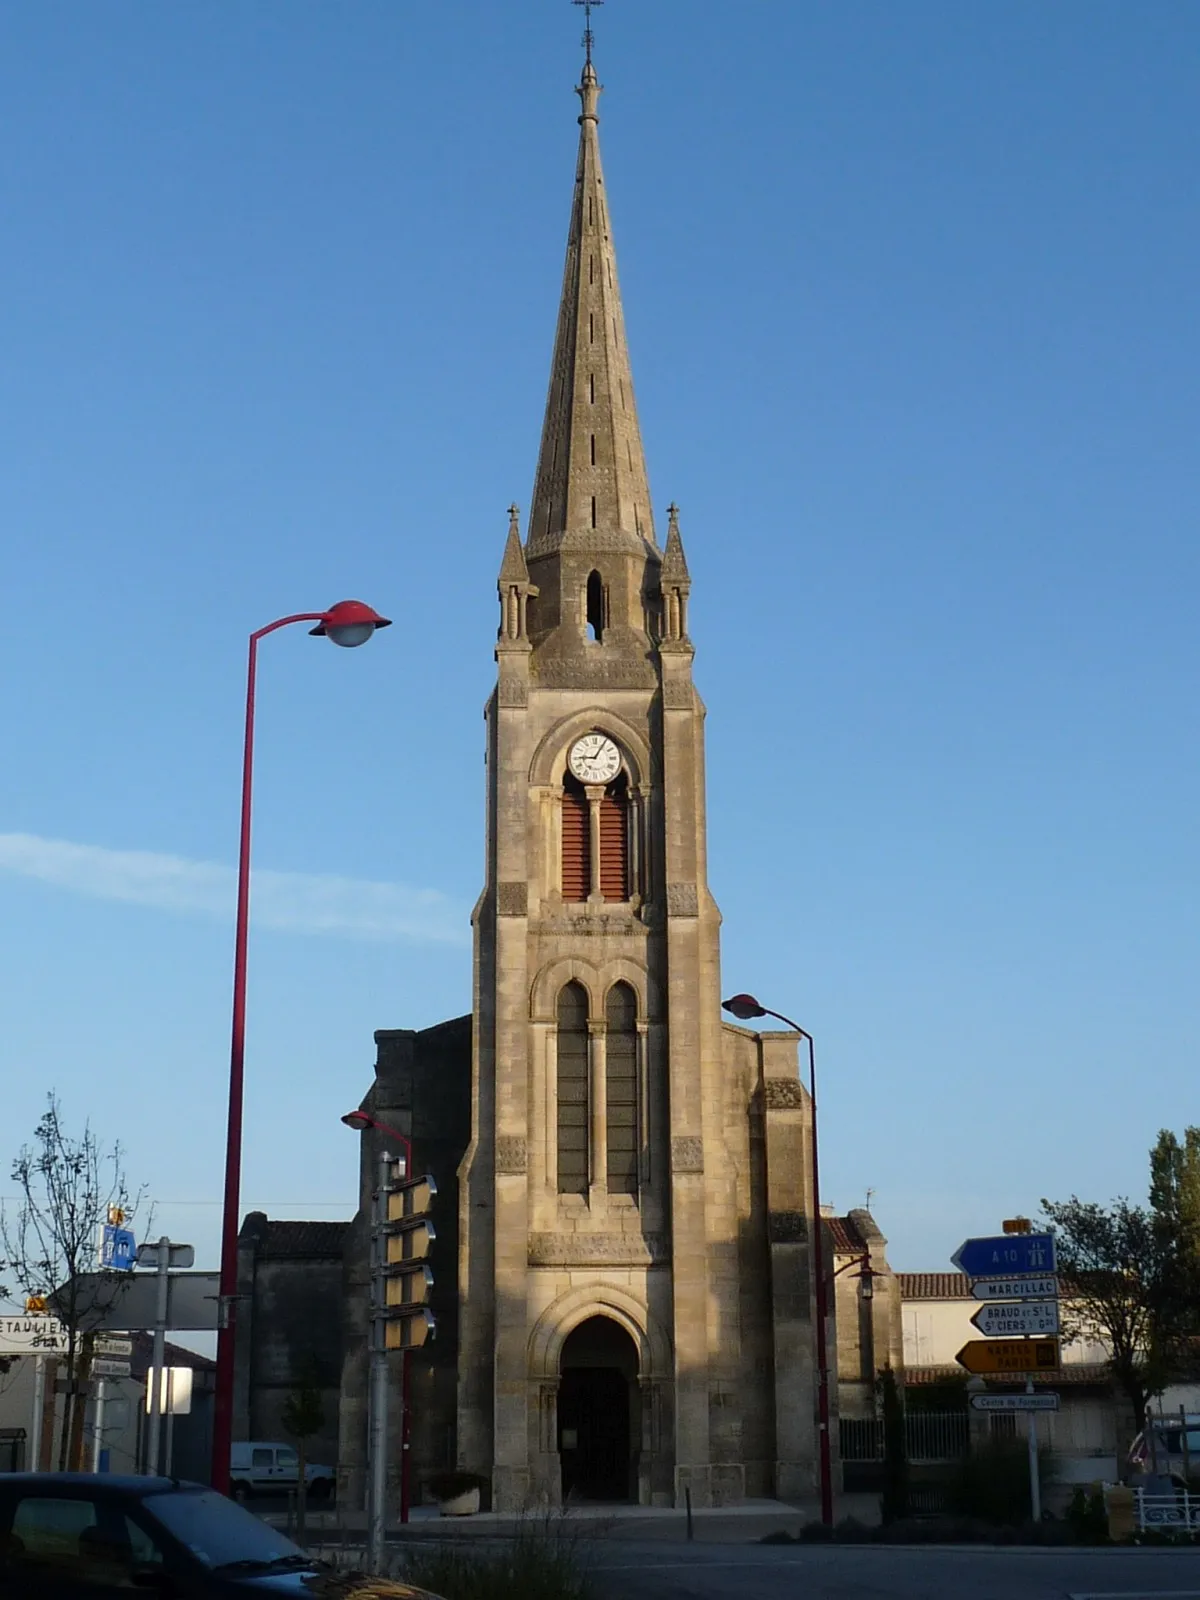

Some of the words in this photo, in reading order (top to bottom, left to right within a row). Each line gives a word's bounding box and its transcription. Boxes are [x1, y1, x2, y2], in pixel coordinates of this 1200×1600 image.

[992, 1250, 1000, 1264] A
[1004, 1249, 1018, 1263] 10
[988, 1282, 1053, 1295] MARCILLAC
[987, 1307, 1020, 1318] BRAUD
[997, 1319, 1026, 1331] CIERS
[998, 1357, 1031, 1369] PARIS
